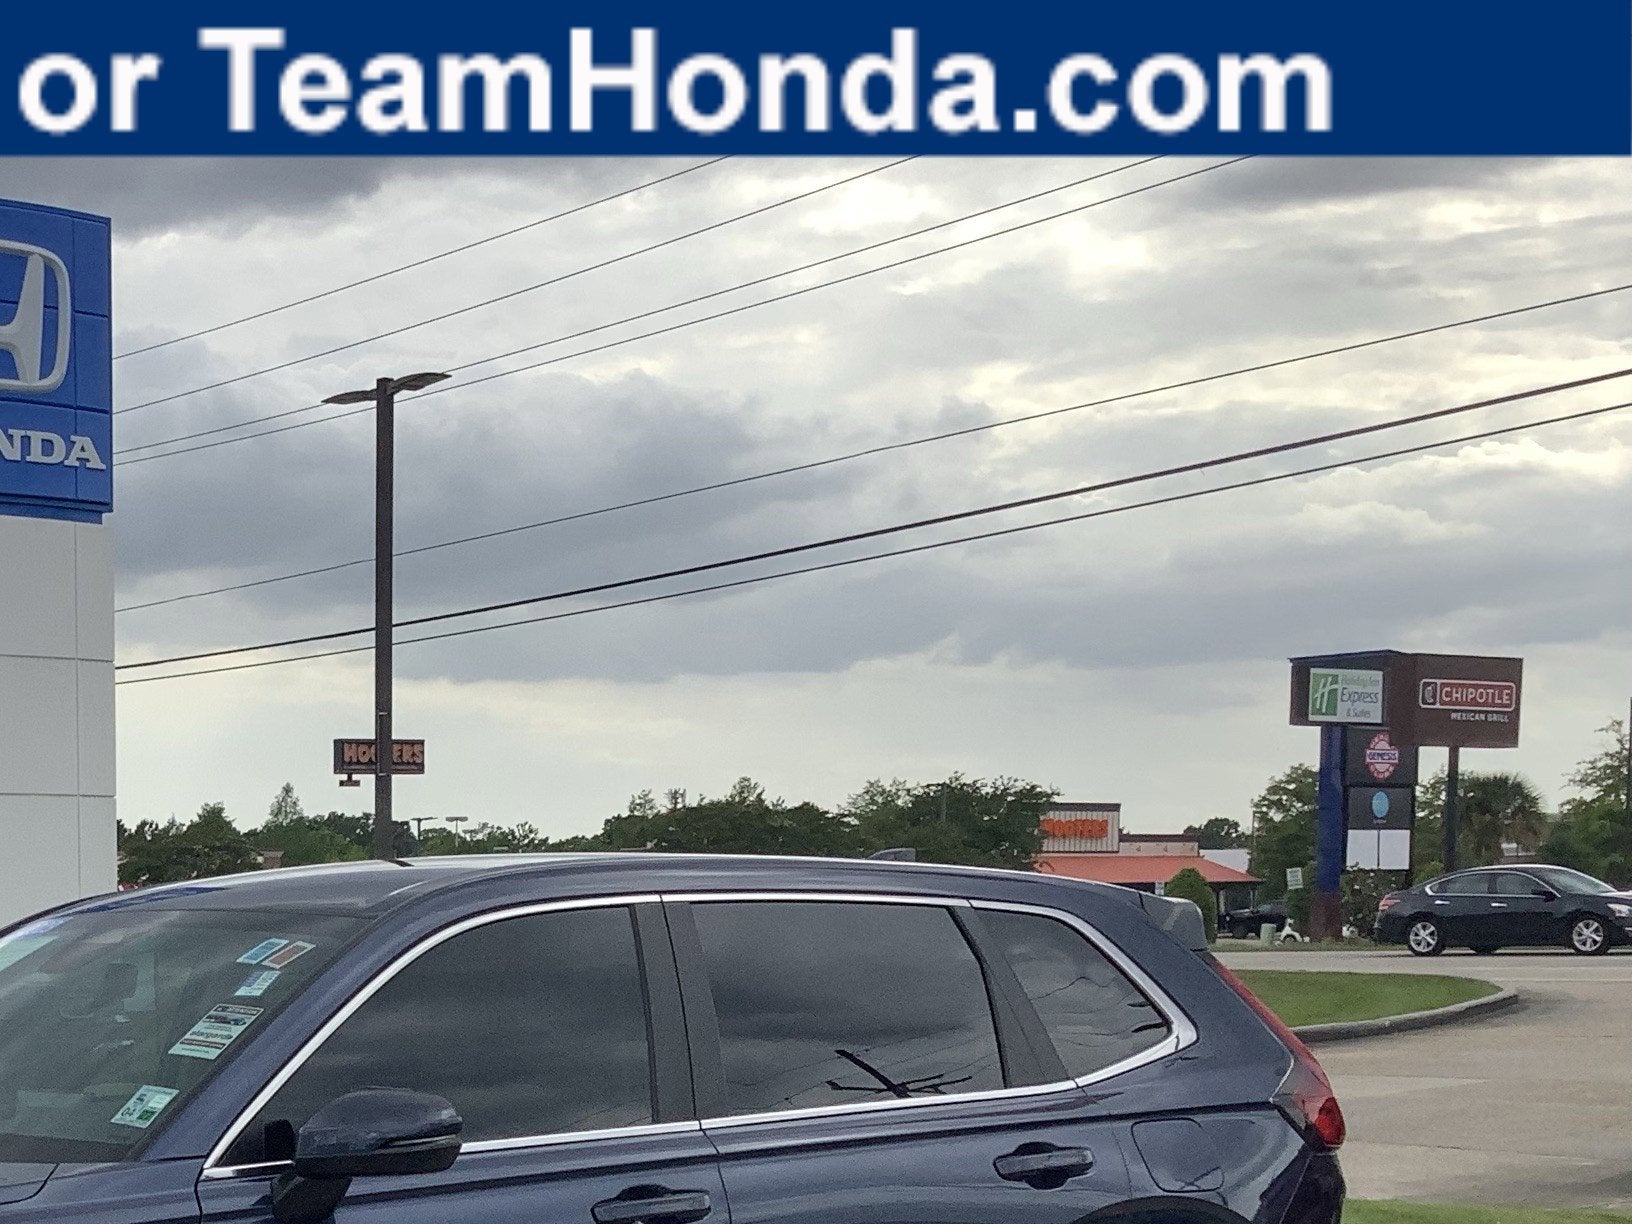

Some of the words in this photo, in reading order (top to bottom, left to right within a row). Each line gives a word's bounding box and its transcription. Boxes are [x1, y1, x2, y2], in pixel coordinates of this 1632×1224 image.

[1341, 687, 1380, 706] Express
[1441, 686, 1511, 704] CHIPOTLE
[1451, 712, 1486, 721] MEXICAN
[1368, 751, 1397, 761] GENESIS
